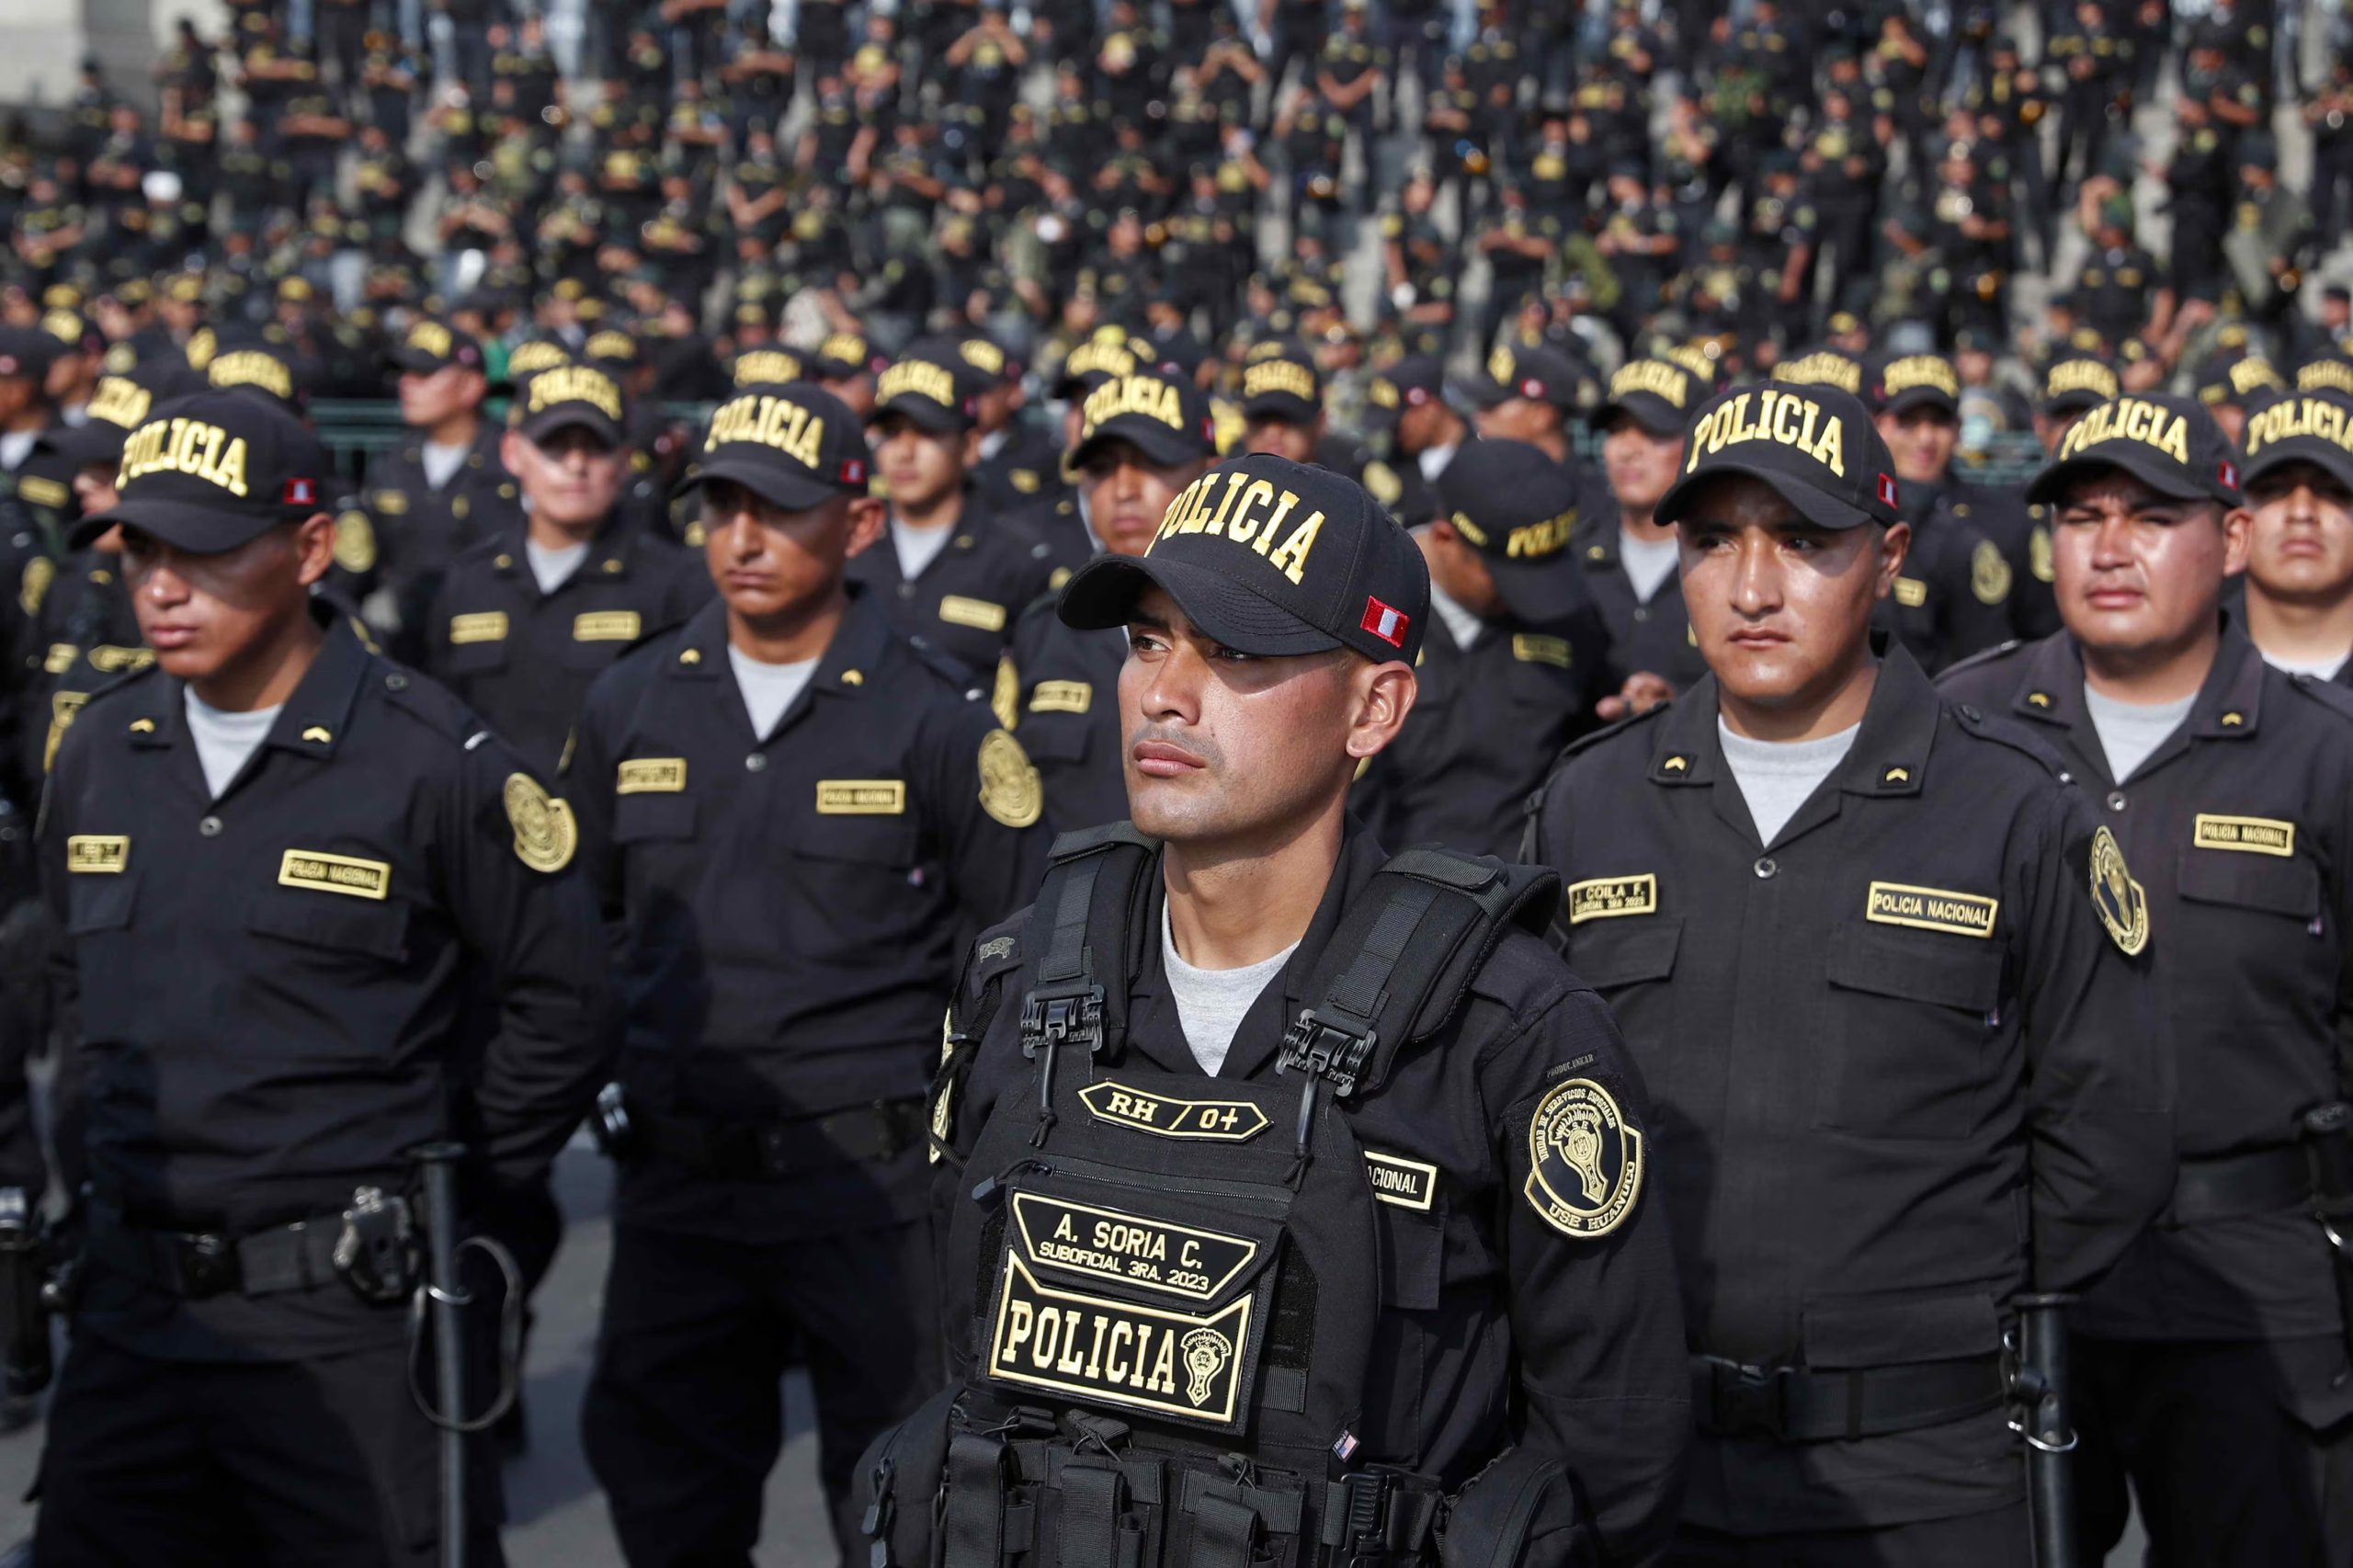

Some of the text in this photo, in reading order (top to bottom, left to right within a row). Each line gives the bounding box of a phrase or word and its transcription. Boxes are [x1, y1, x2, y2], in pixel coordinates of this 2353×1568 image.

[115, 417, 248, 497] POLICIA
[704, 395, 824, 469] POLICIA
[1686, 389, 1845, 477] POLICIA
[2060, 397, 2189, 464] POLICIA
[1143, 472, 1325, 585] POLICIA
[1586, 884, 1626, 902] COILA
[1873, 892, 1988, 926] POLICIA NACIONAL
[1106, 1091, 1158, 1122] RH
[1549, 1202, 1581, 1228] USE
[1587, 1161, 1635, 1230] HUANUCO
[1039, 1242, 1210, 1291] SUBOFICIAL 3RA. 2023
[1053, 1213, 1202, 1269] A. SORIA C.
[1002, 1299, 1176, 1395] POLICIA
